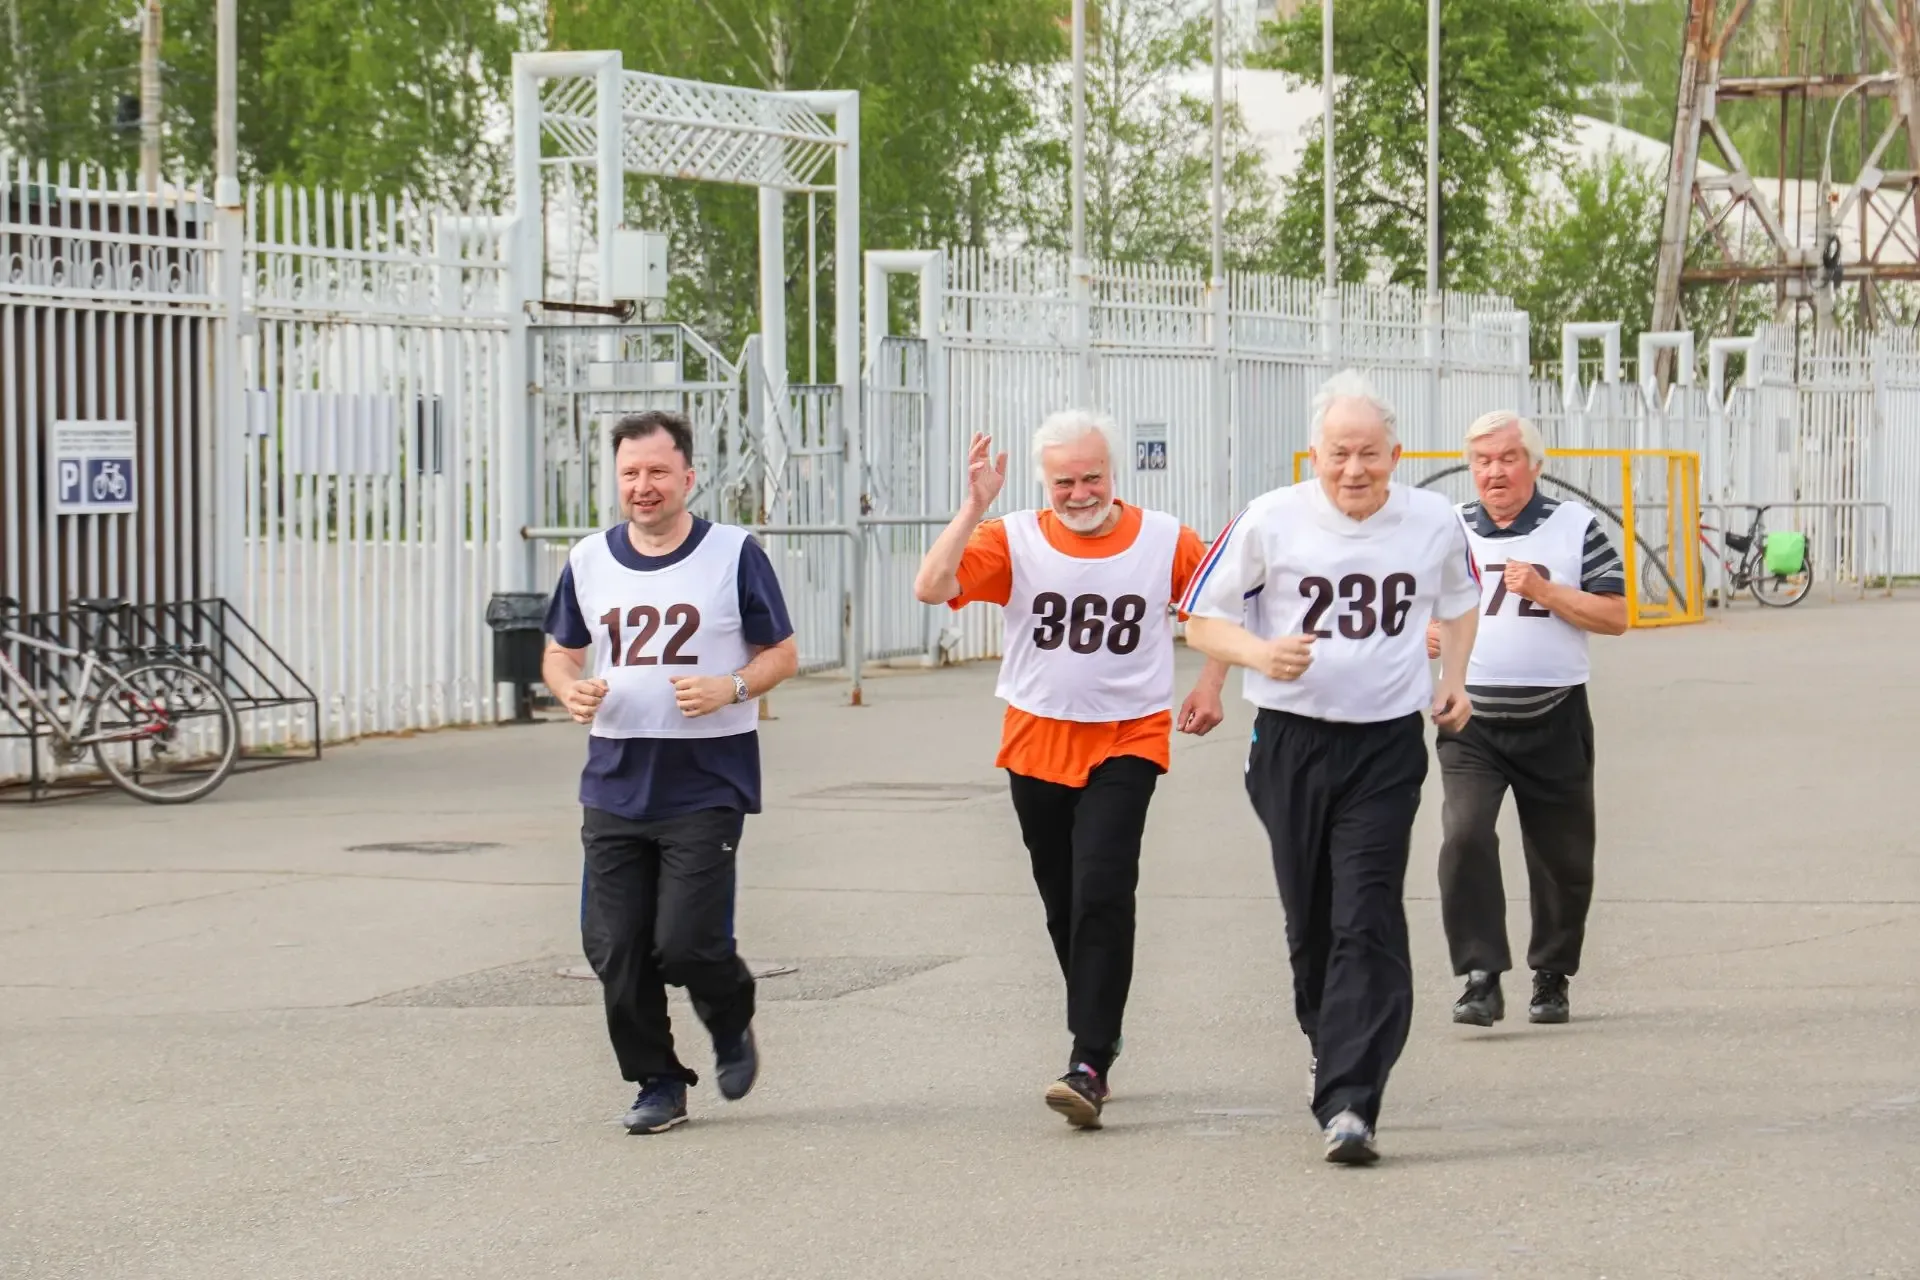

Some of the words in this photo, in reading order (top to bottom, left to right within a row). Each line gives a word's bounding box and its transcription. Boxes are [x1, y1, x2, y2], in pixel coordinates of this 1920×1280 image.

[61, 462, 79, 500] P
[1138, 444, 1145, 468] P
[599, 603, 701, 667] 122
[1032, 591, 1147, 655] 368
[1298, 572, 1417, 640] 236
